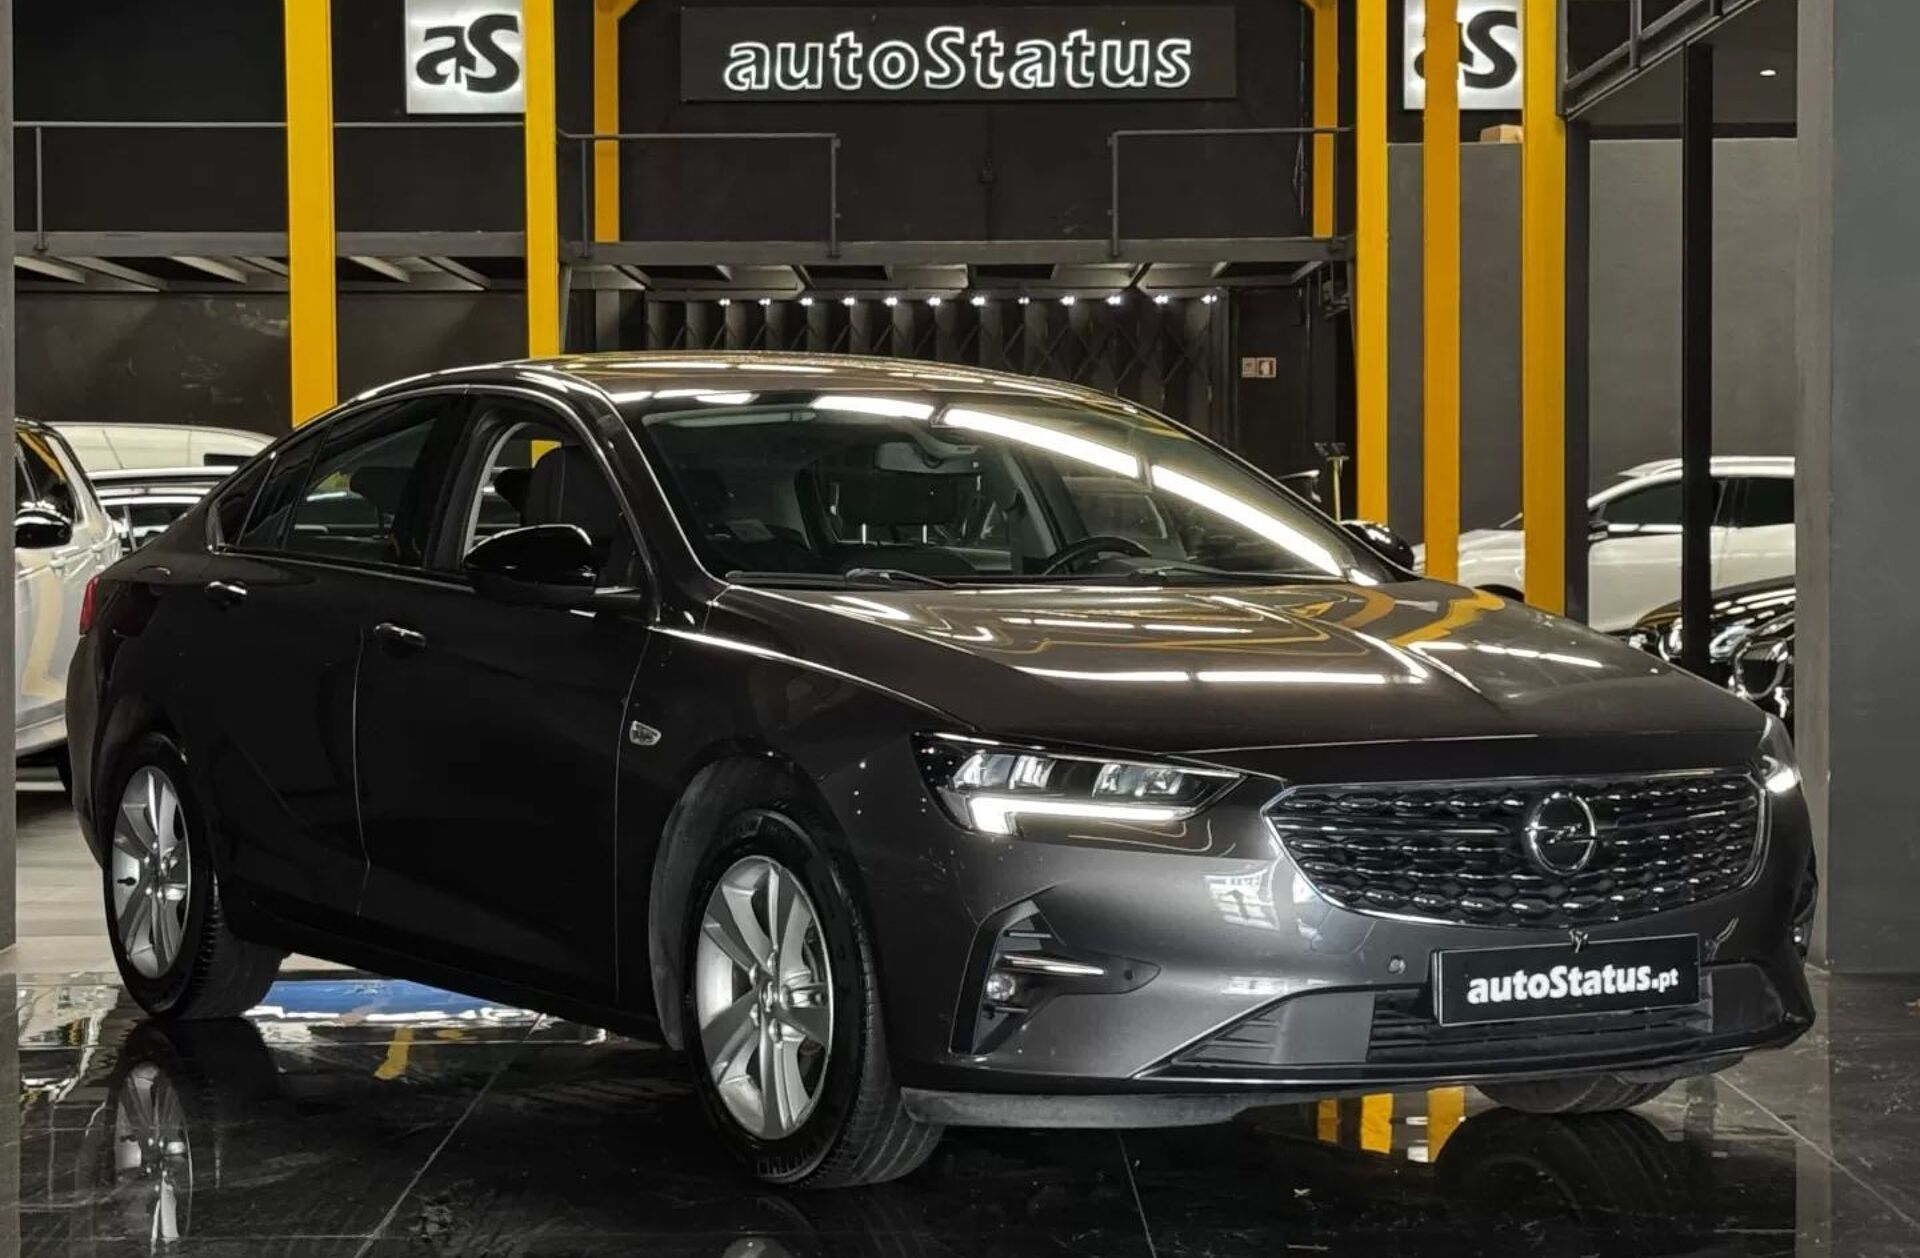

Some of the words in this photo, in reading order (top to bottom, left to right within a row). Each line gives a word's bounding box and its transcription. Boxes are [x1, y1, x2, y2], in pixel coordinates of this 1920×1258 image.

[416, 14, 520, 93] aS
[723, 25, 1192, 91] autoStatus
[1466, 963, 1679, 1005] autoStatus.pt
